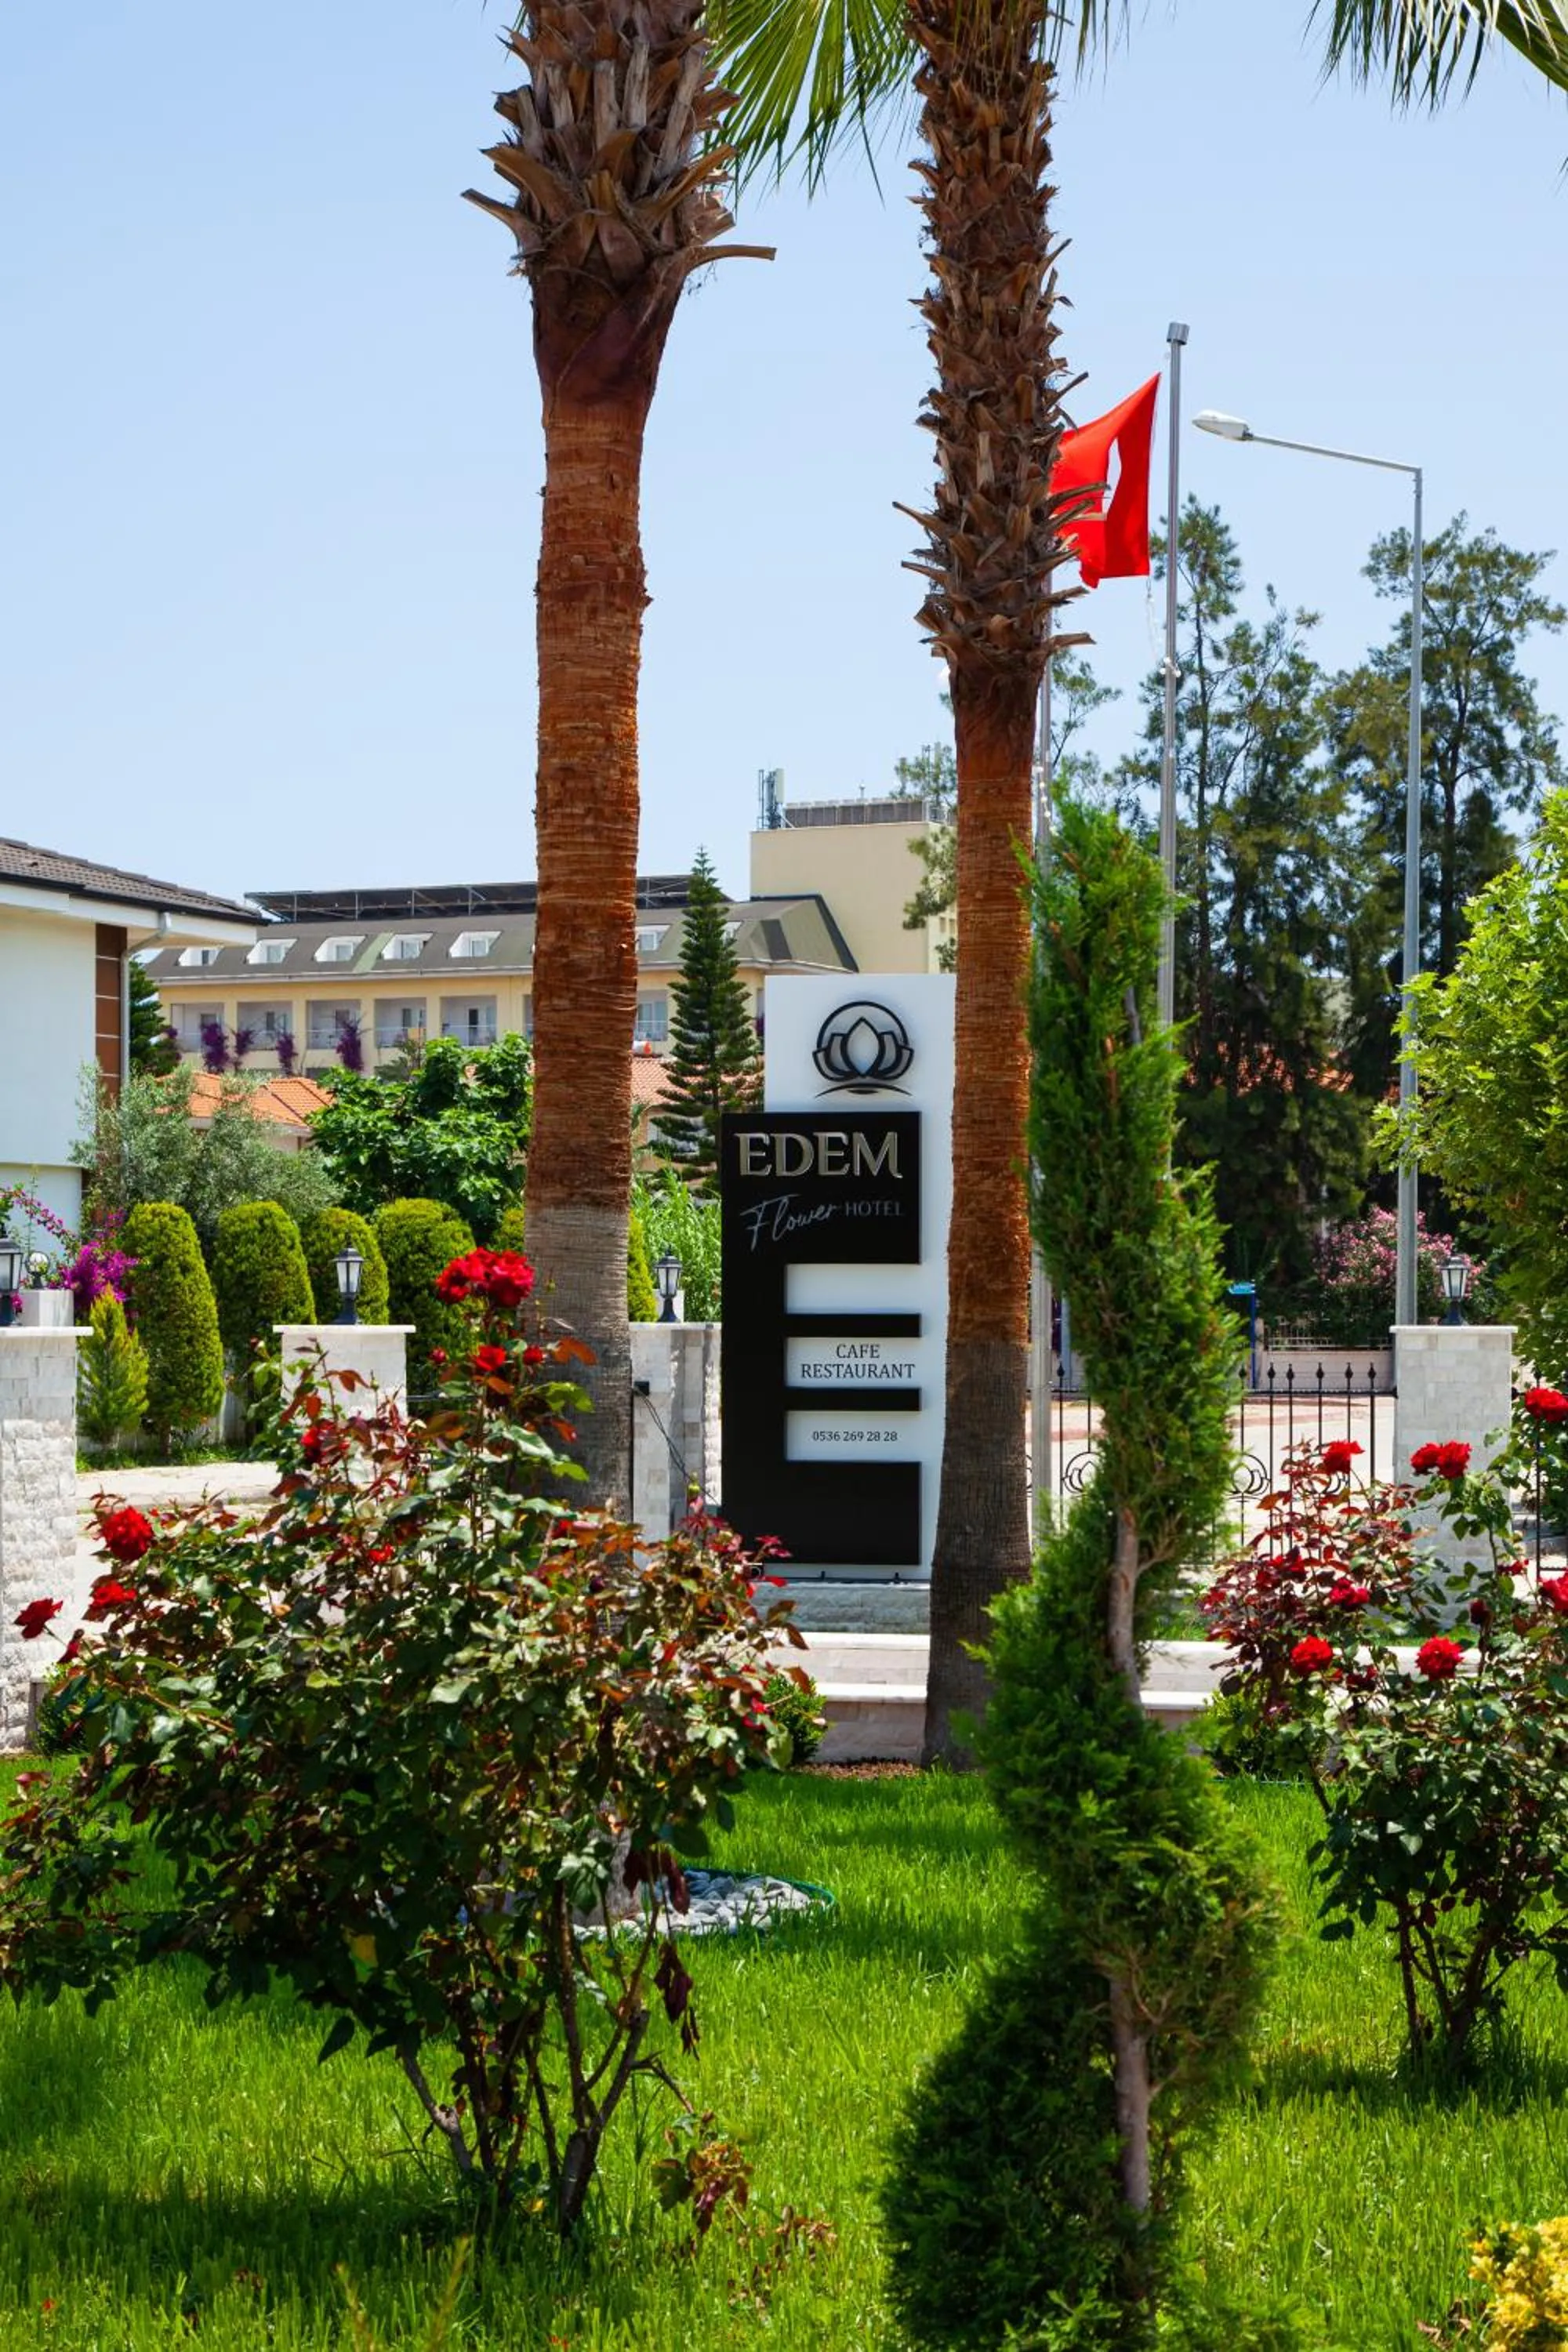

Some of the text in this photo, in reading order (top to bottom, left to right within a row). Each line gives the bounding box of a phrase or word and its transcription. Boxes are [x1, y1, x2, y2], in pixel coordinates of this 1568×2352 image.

[735, 1131, 903, 1178] EDEM
[740, 1193, 903, 1250] Flower HOTEL
[836, 1343, 880, 1359] CAFE
[800, 1363, 916, 1379] RESTAURANT
[812, 1431, 898, 1442] 0536 269 28 28
